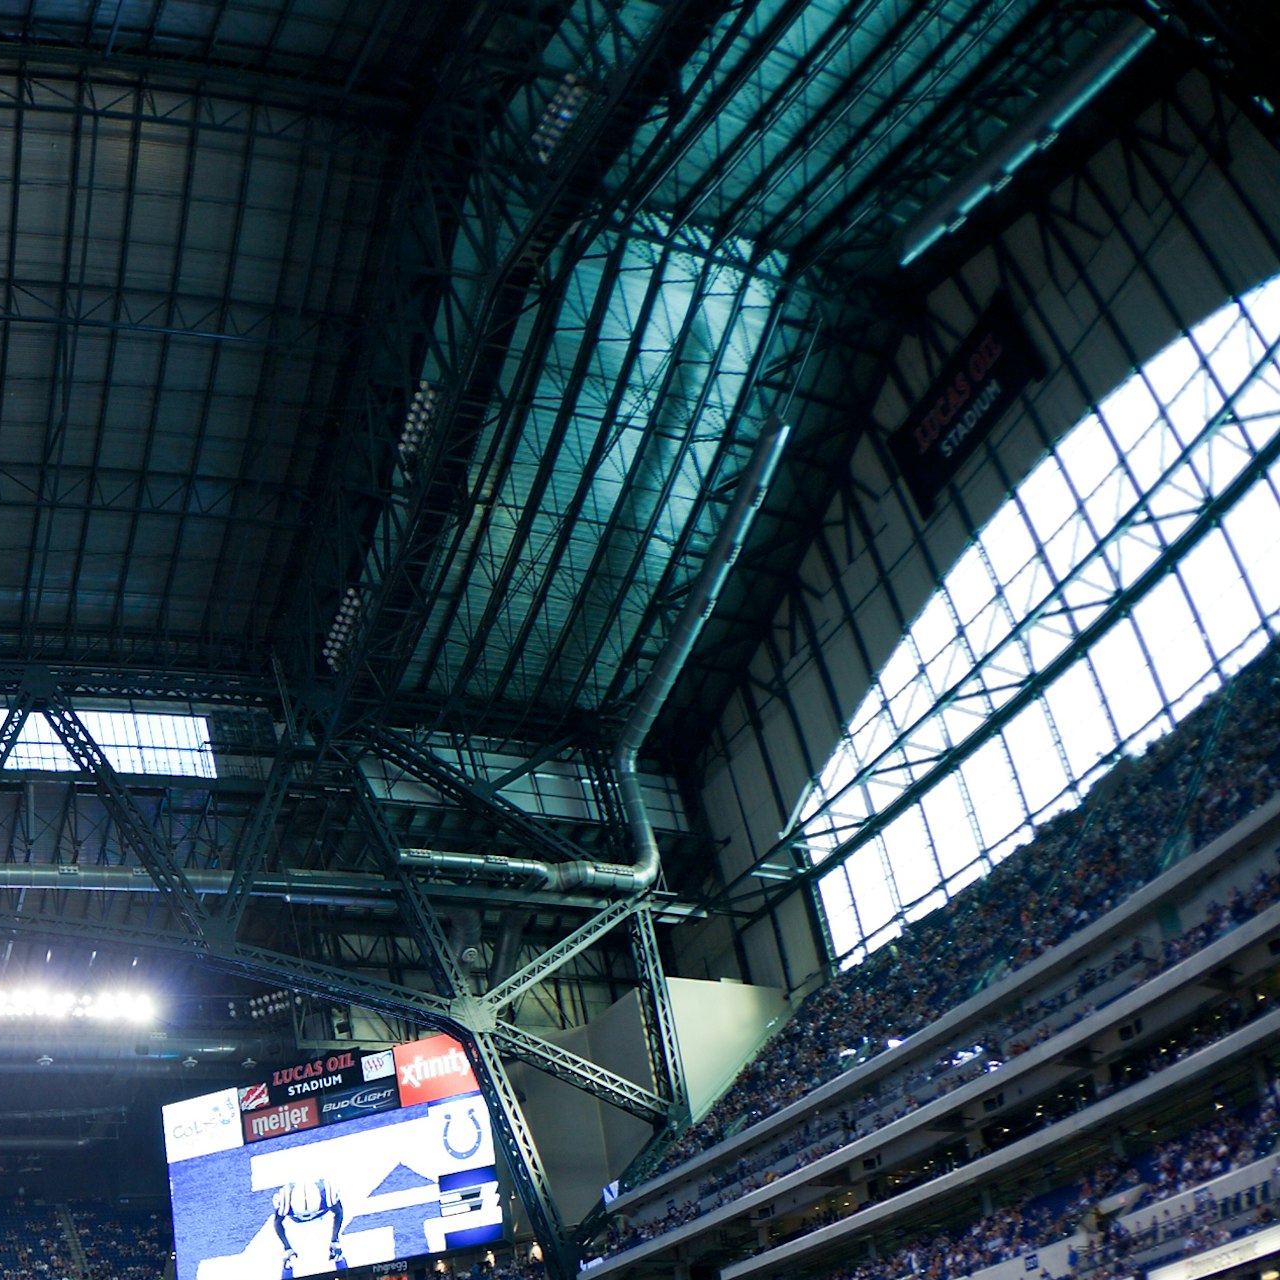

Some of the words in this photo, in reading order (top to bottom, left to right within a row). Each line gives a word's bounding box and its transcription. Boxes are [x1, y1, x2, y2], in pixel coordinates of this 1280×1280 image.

[941, 379, 1001, 457] STADIUM
[272, 1060, 323, 1086] LUCAS
[325, 1052, 356, 1072] OIL
[400, 1047, 471, 1089] xfinity
[288, 1074, 343, 1096] STADIUM
[322, 1101, 350, 1114] BUD
[357, 1088, 395, 1103] LIGHT
[252, 1103, 309, 1135] meijer
